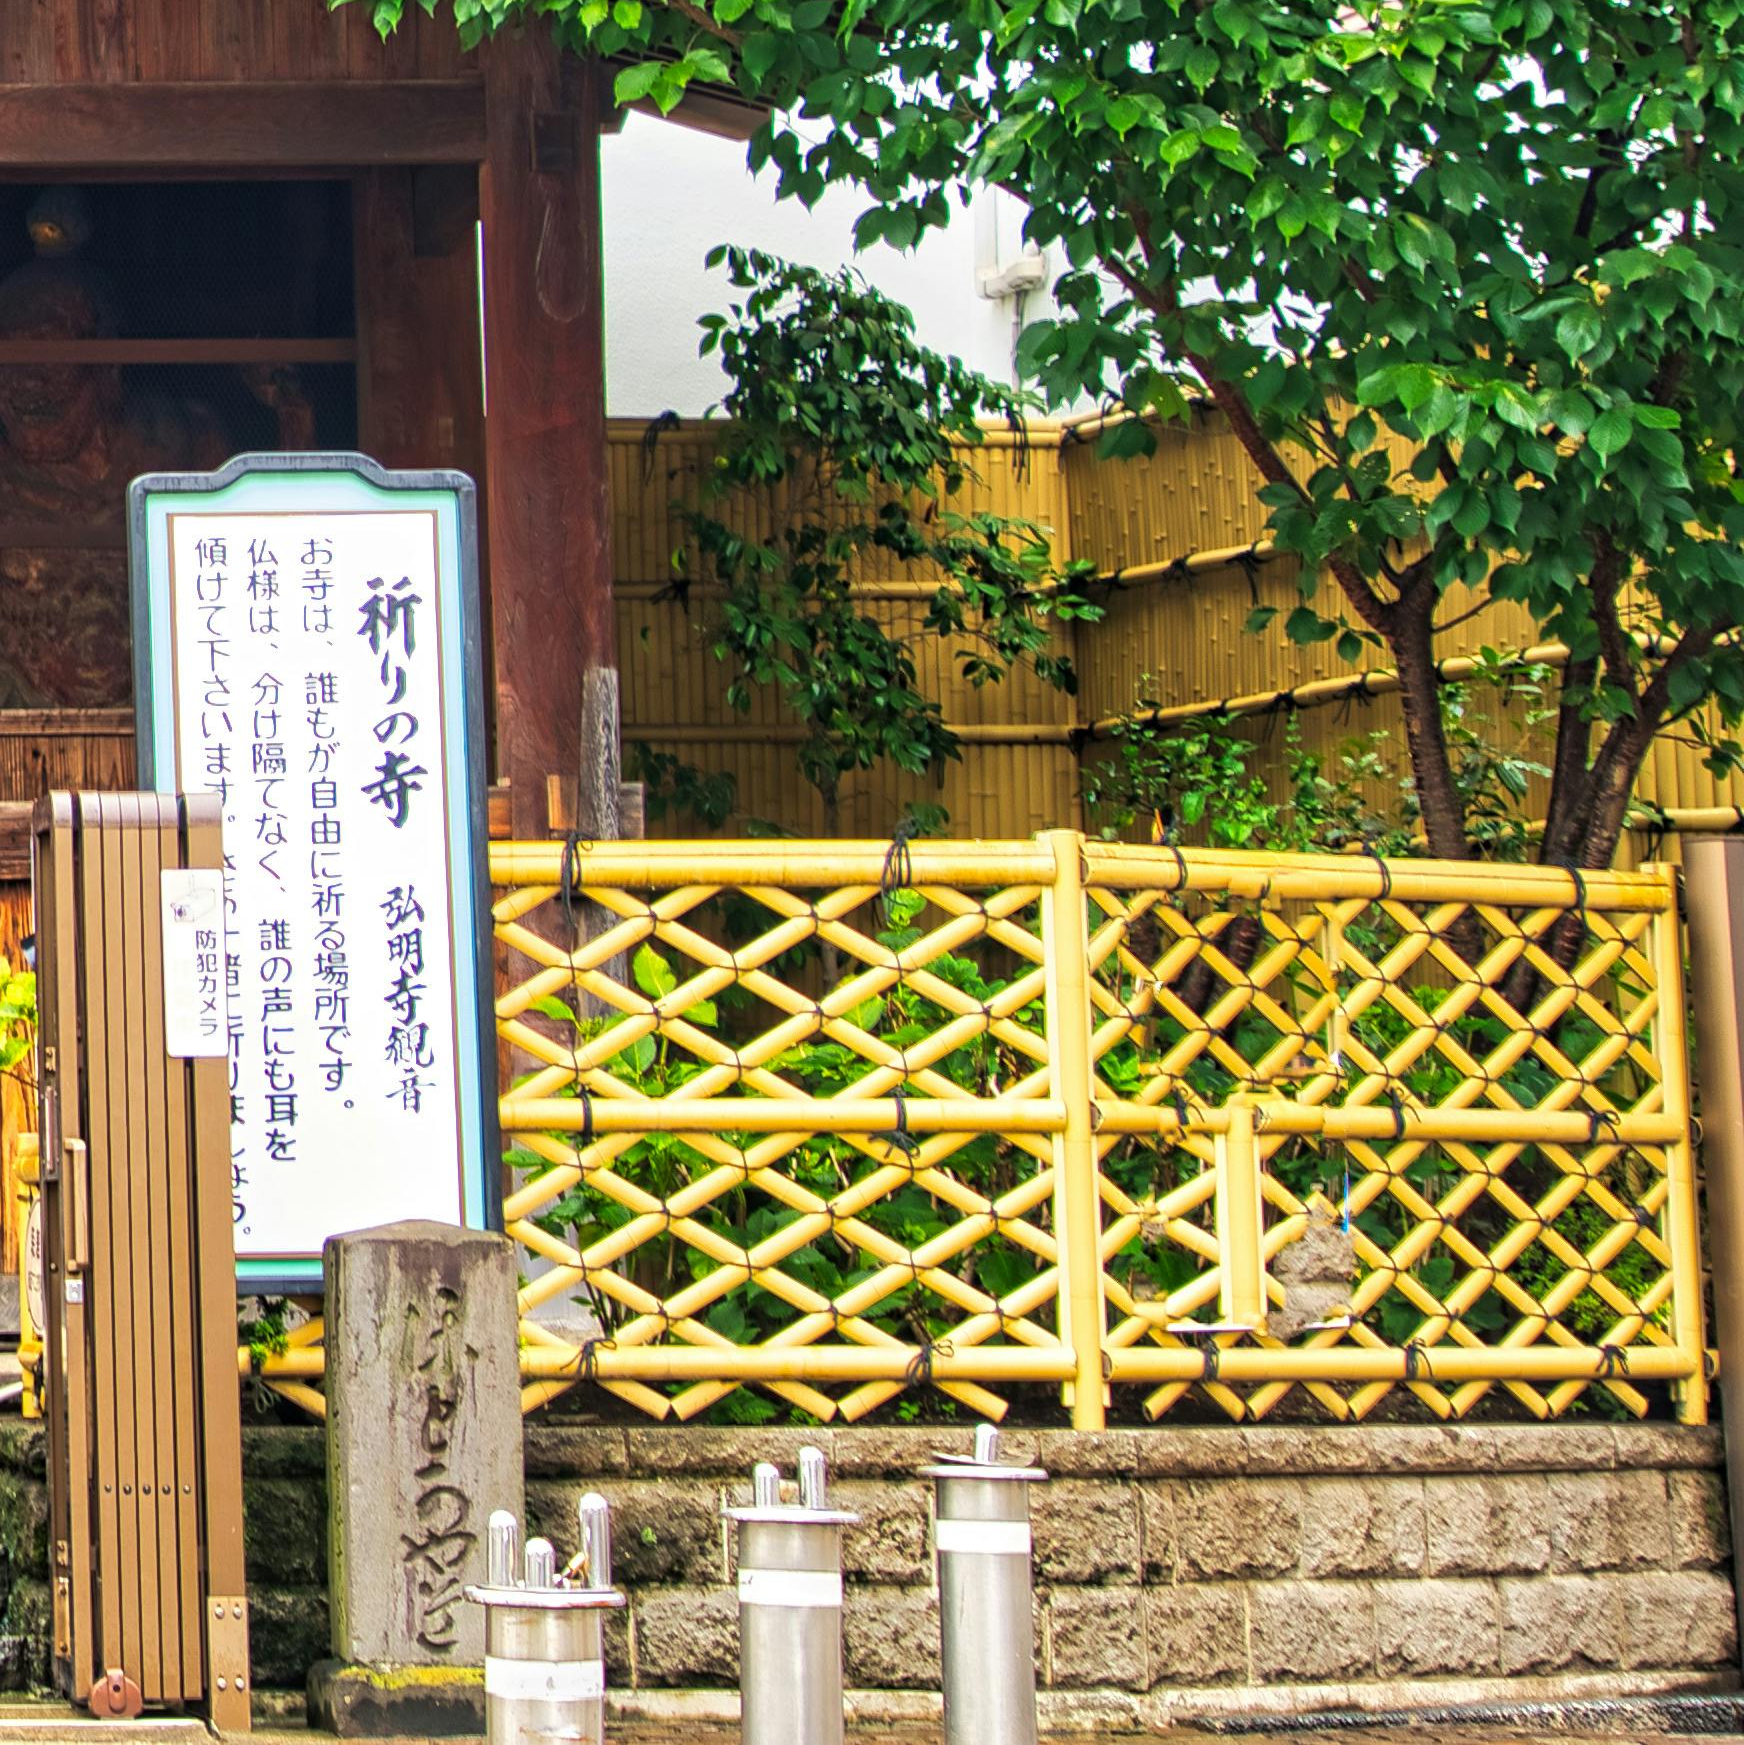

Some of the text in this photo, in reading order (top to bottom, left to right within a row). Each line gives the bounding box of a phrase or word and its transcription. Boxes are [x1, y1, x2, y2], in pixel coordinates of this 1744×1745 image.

[356, 574, 433, 830] 祈りの寺
[194, 929, 219, 1037] 防犯カメラ
